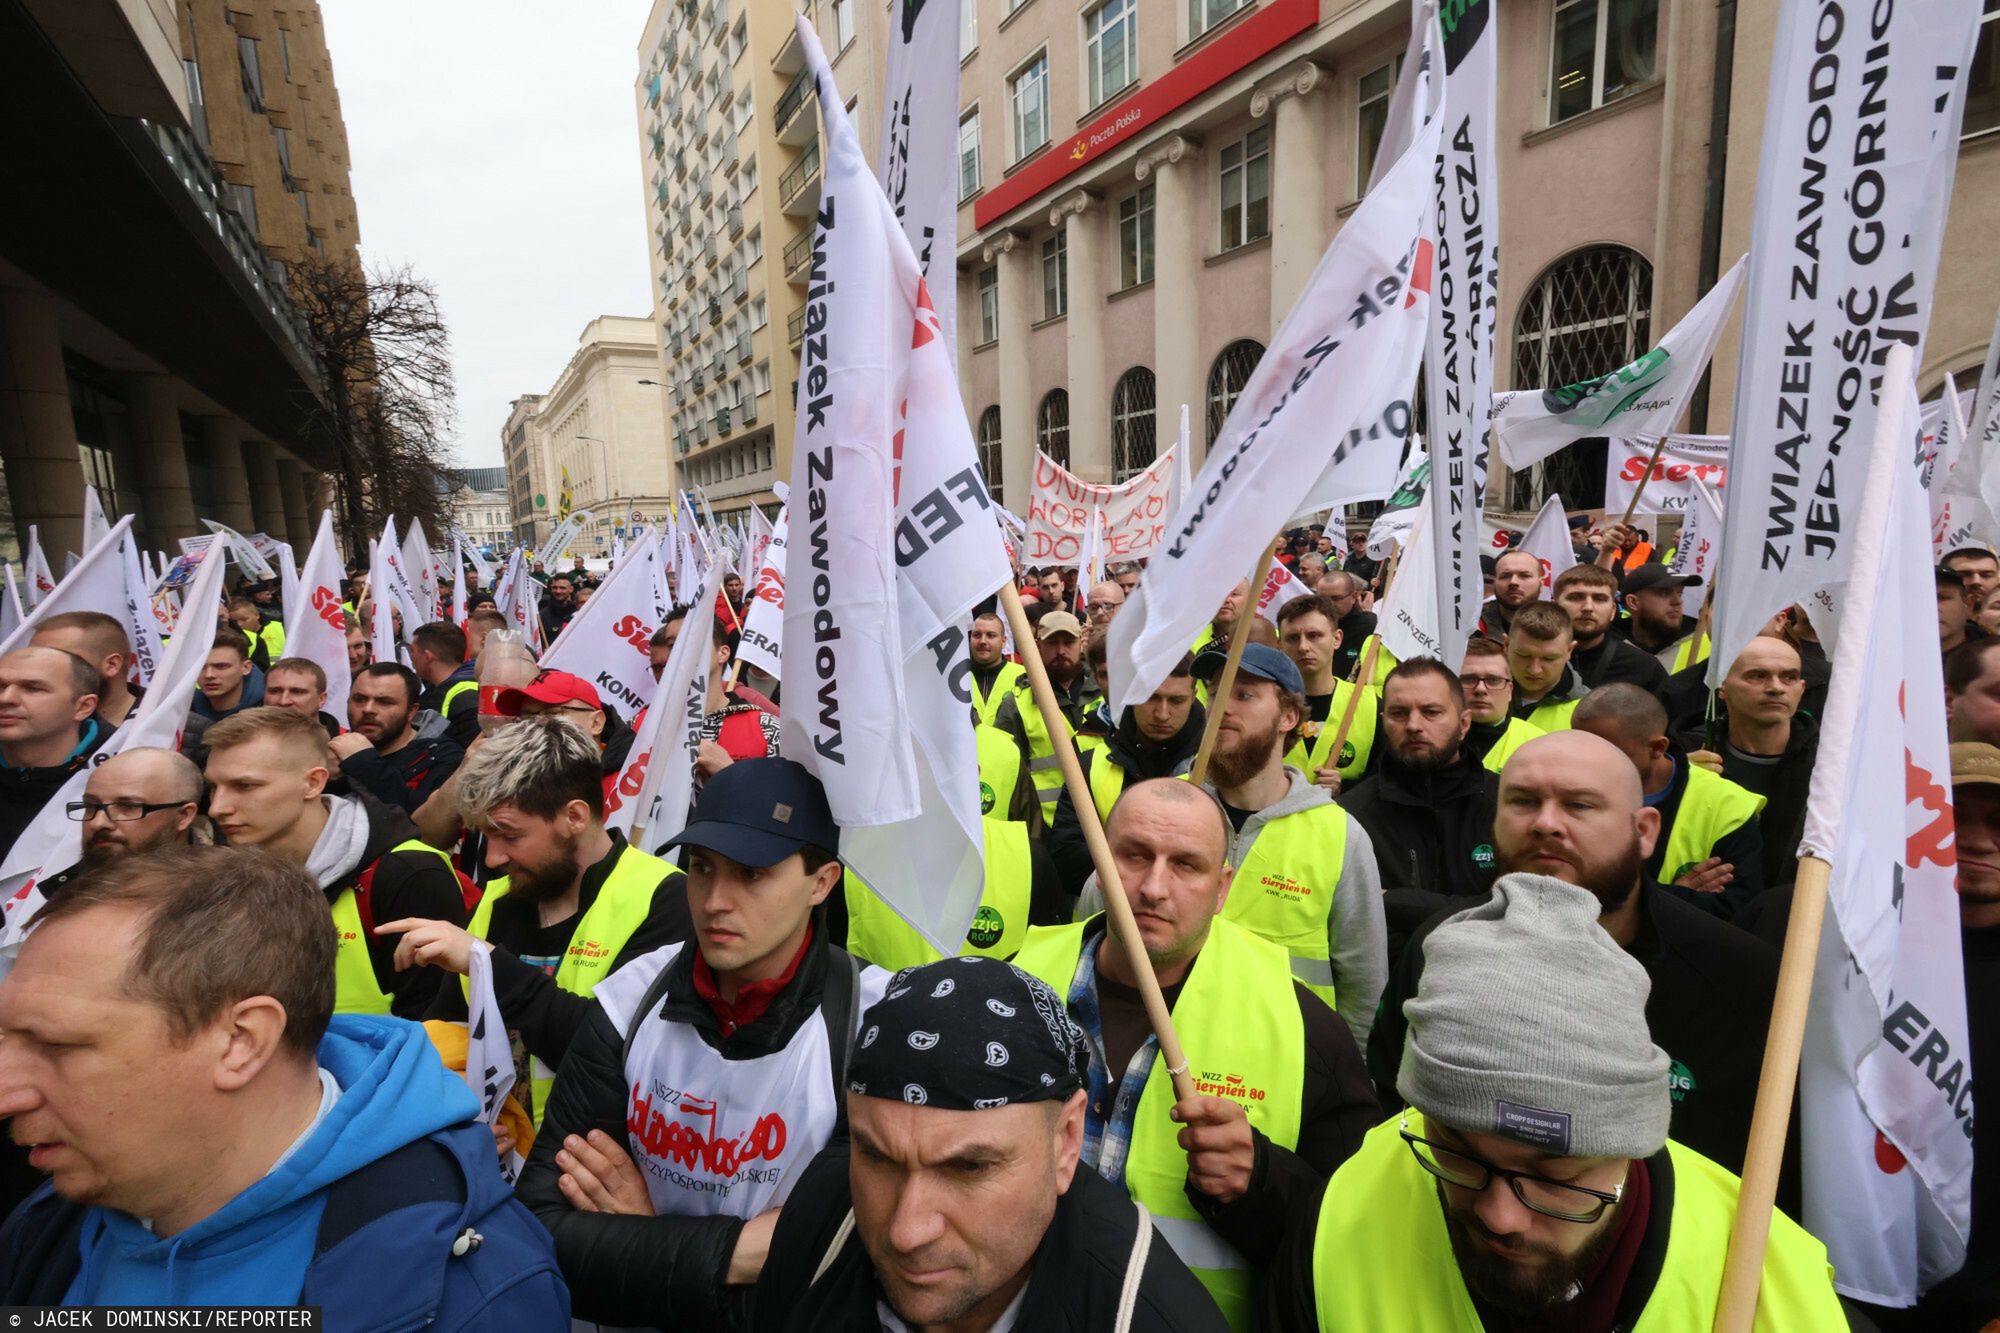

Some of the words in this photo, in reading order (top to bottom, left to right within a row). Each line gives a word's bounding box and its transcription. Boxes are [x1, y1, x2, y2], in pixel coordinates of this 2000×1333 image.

[1090, 125, 1115, 148] Poczta
[1116, 108, 1141, 132] Polska
[1761, 319, 1815, 573] ZWIĄZEK
[311, 585, 347, 631] Sie
[806, 445, 846, 766] Zawodowy
[612, 614, 653, 658] Sie
[651, 1079, 682, 1107] NSZZ
[1191, 1078, 1246, 1098] ierpień
[1249, 1087, 1266, 1101] 80
[1202, 1071, 1222, 1081] WZZ
